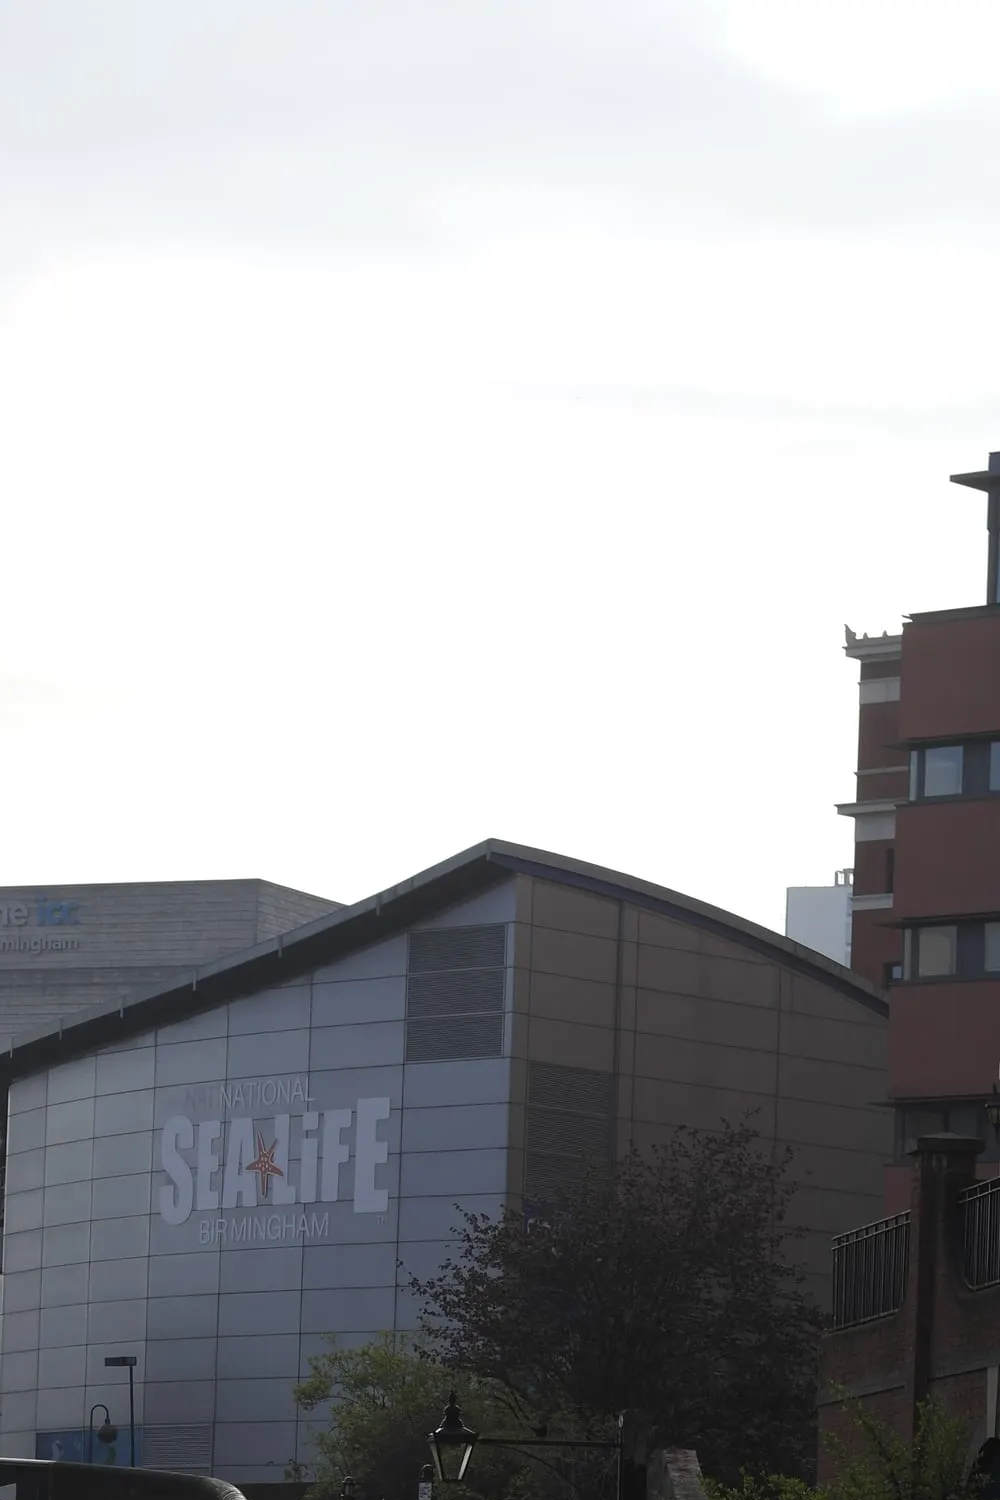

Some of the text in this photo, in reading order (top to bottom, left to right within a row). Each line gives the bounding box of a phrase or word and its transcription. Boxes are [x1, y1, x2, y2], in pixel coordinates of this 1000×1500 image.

[220, 1076, 316, 1110] NATIONAL
[159, 1114, 258, 1226] SEA
[199, 1211, 329, 1245] BIRMINGHAM
